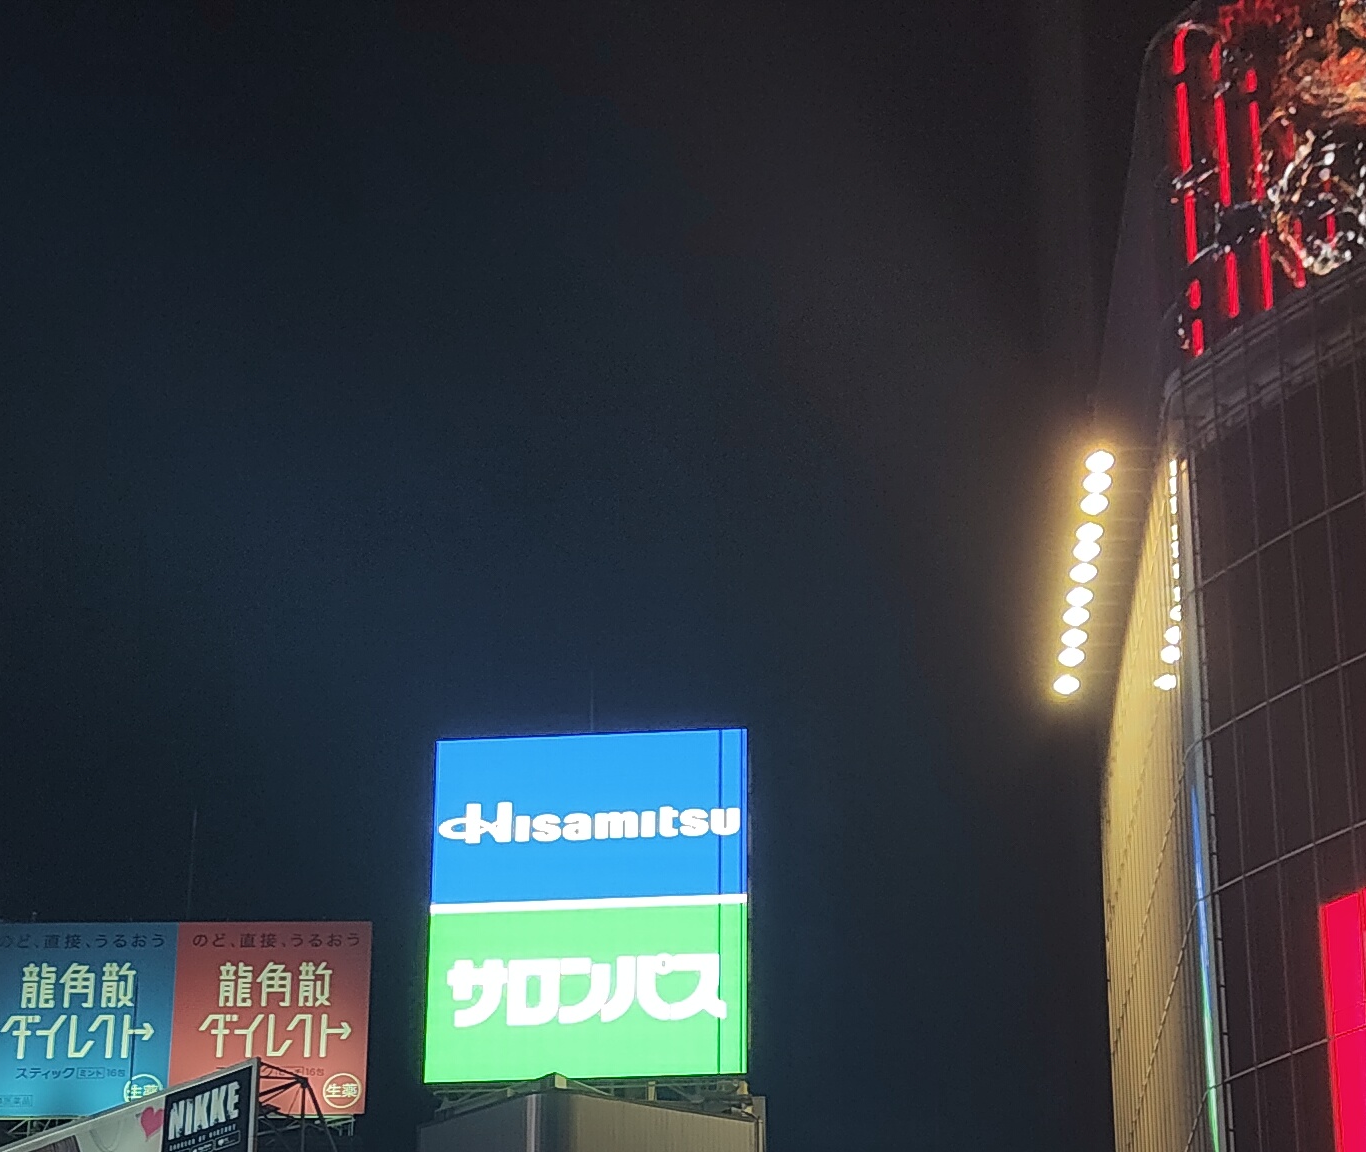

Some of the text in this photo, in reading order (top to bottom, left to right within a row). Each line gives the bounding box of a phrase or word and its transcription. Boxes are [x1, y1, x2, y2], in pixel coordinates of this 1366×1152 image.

[438, 801, 741, 845] Hisamitsu
[192, 932, 361, 950] のど、直接、うるおう
[19, 960, 137, 1009] 龍角散
[217, 960, 334, 1009] 龍角散
[446, 952, 728, 1029] サロンパス
[0, 1014, 156, 1060] ダイレクト
[198, 1013, 352, 1060] ダイレクト
[15, 1066, 75, 1080] スティック
[78, 1068, 104, 1079] ミント
[326, 1083, 358, 1098] 生薬
[167, 1081, 241, 1142] NIKKE
